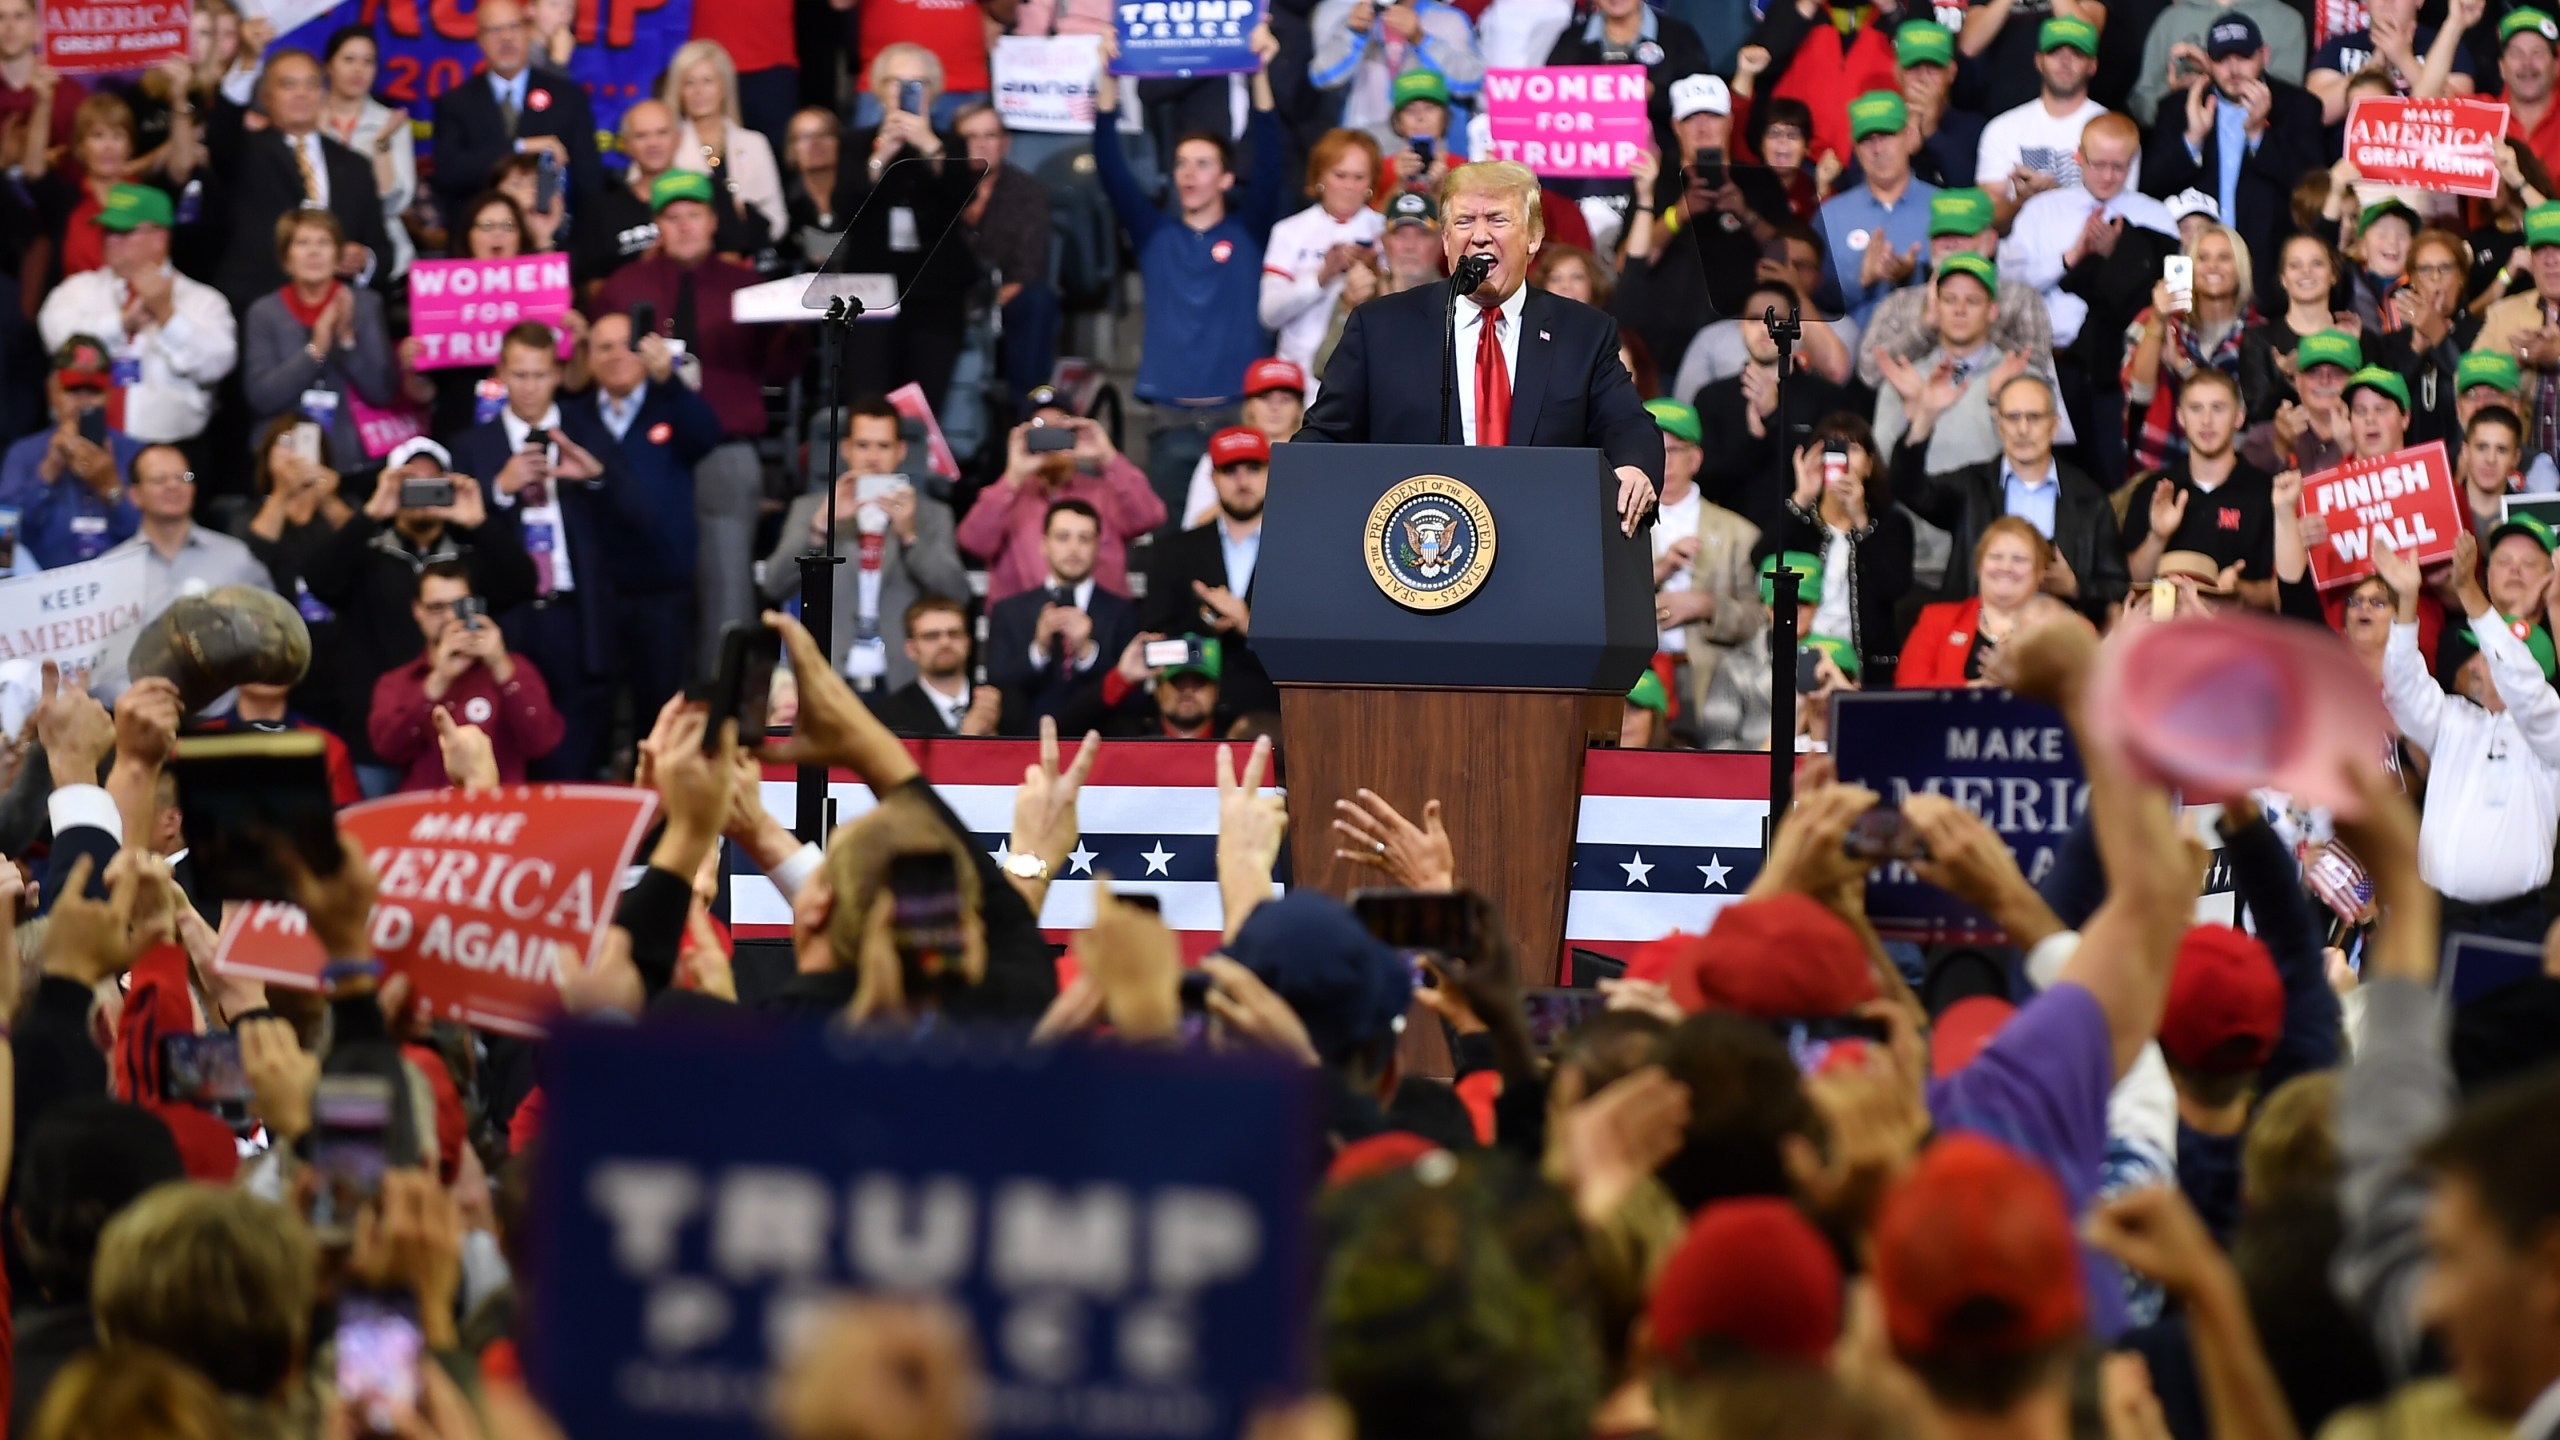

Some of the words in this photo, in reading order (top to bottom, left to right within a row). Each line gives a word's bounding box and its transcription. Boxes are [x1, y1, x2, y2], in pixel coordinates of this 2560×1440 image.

[49, 4, 190, 32] AMERICA
[1119, 0, 1253, 24] TRUMP
[53, 34, 116, 55] GREAT
[119, 30, 182, 50] AGAIN
[1129, 21, 1241, 39] PENCE
[1488, 74, 1646, 103] WOMEN
[1535, 111, 1594, 133] FOR
[2402, 107, 2455, 124] MAKE
[2351, 118, 2494, 153] AMERICA
[1497, 139, 1638, 168] TRUMP
[2356, 145, 2419, 169] GREAT
[2421, 151, 2486, 178] AGAIN
[410, 261, 570, 296] WOMEN
[460, 301, 520, 324] FOR
[1431, 481, 1444, 491] OF
[1446, 484, 1463, 498] THE
[2316, 459, 2431, 517] FINISH
[1369, 480, 1428, 540] PRESIDENT
[1464, 495, 1492, 550] UNITED
[2355, 500, 2394, 526] THE
[2331, 511, 2438, 564] WALL
[1370, 544, 1380, 562] THE
[1375, 564, 1386, 577] OF
[1440, 561, 1486, 603] STATES
[40, 581, 101, 612] KEEP
[1384, 575, 1418, 603] SEAL
[0, 601, 142, 661] AMERICA
[1944, 726, 2064, 763] MAKE
[409, 811, 528, 845] MAKE
[370, 846, 596, 932] ERICA
[592, 1158, 1266, 1302] TRUMP
